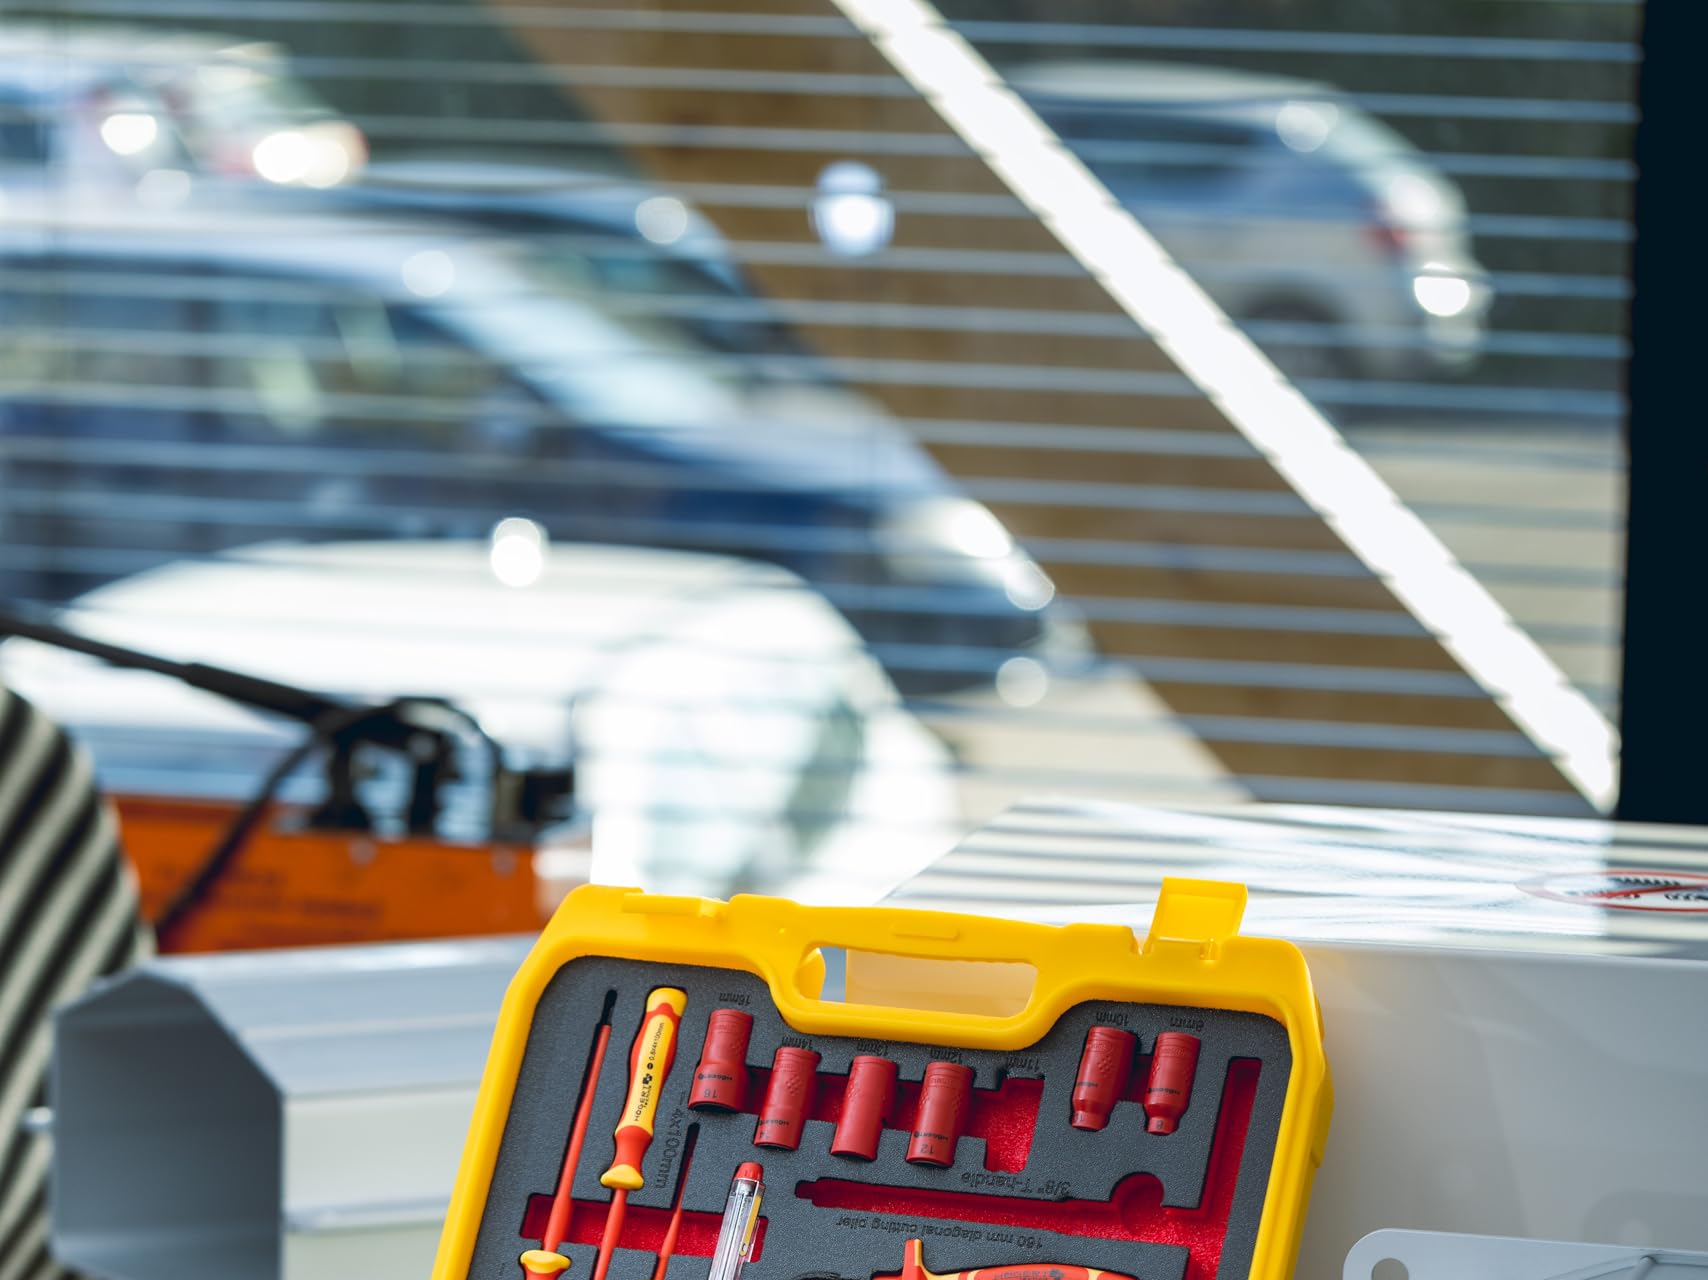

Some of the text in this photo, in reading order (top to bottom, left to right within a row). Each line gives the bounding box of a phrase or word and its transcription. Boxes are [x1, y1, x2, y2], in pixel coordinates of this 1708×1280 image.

[1096, 1012, 1129, 1027] 10mm
[1006, 1056, 1041, 1072] 11mm
[703, 1088, 719, 1099] 16
[919, 1143, 934, 1155] 12
[961, 1170, 1033, 1195] T-handle
[836, 1215, 869, 1230] plier
[871, 1217, 918, 1235] cutting
[921, 1223, 983, 1243] diagonal
[986, 1231, 1013, 1245] mm
